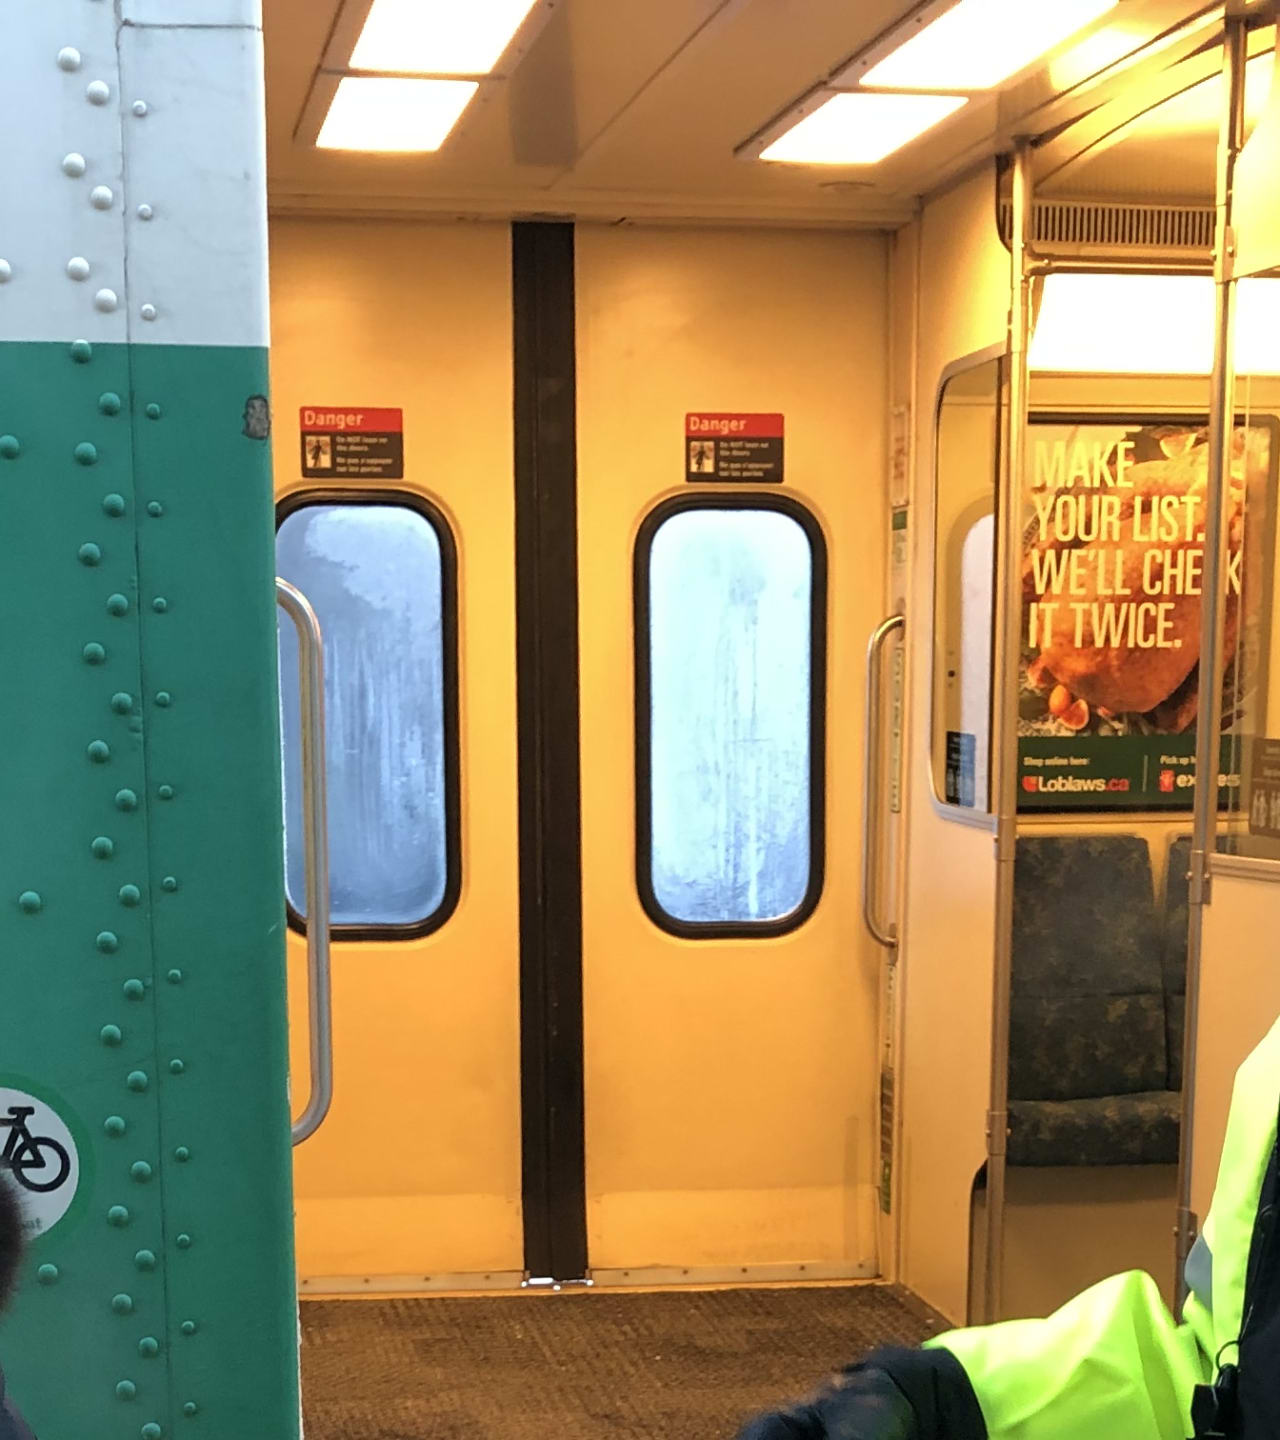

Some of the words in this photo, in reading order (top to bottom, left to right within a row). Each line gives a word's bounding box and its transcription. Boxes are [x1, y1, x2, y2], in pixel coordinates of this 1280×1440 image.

[304, 410, 364, 430] Danger
[690, 416, 746, 435] Danger
[1033, 440, 1135, 488] MAKE
[1032, 495, 1120, 542] YOUR
[1134, 496, 1206, 541] LIST.
[1032, 549, 1131, 596] WE'LL
[1142, 549, 1241, 595] CHEK
[1028, 602, 1059, 648] IT
[1073, 602, 1182, 649] TWICE.
[1038, 775, 1130, 793] Loblaws.ca
